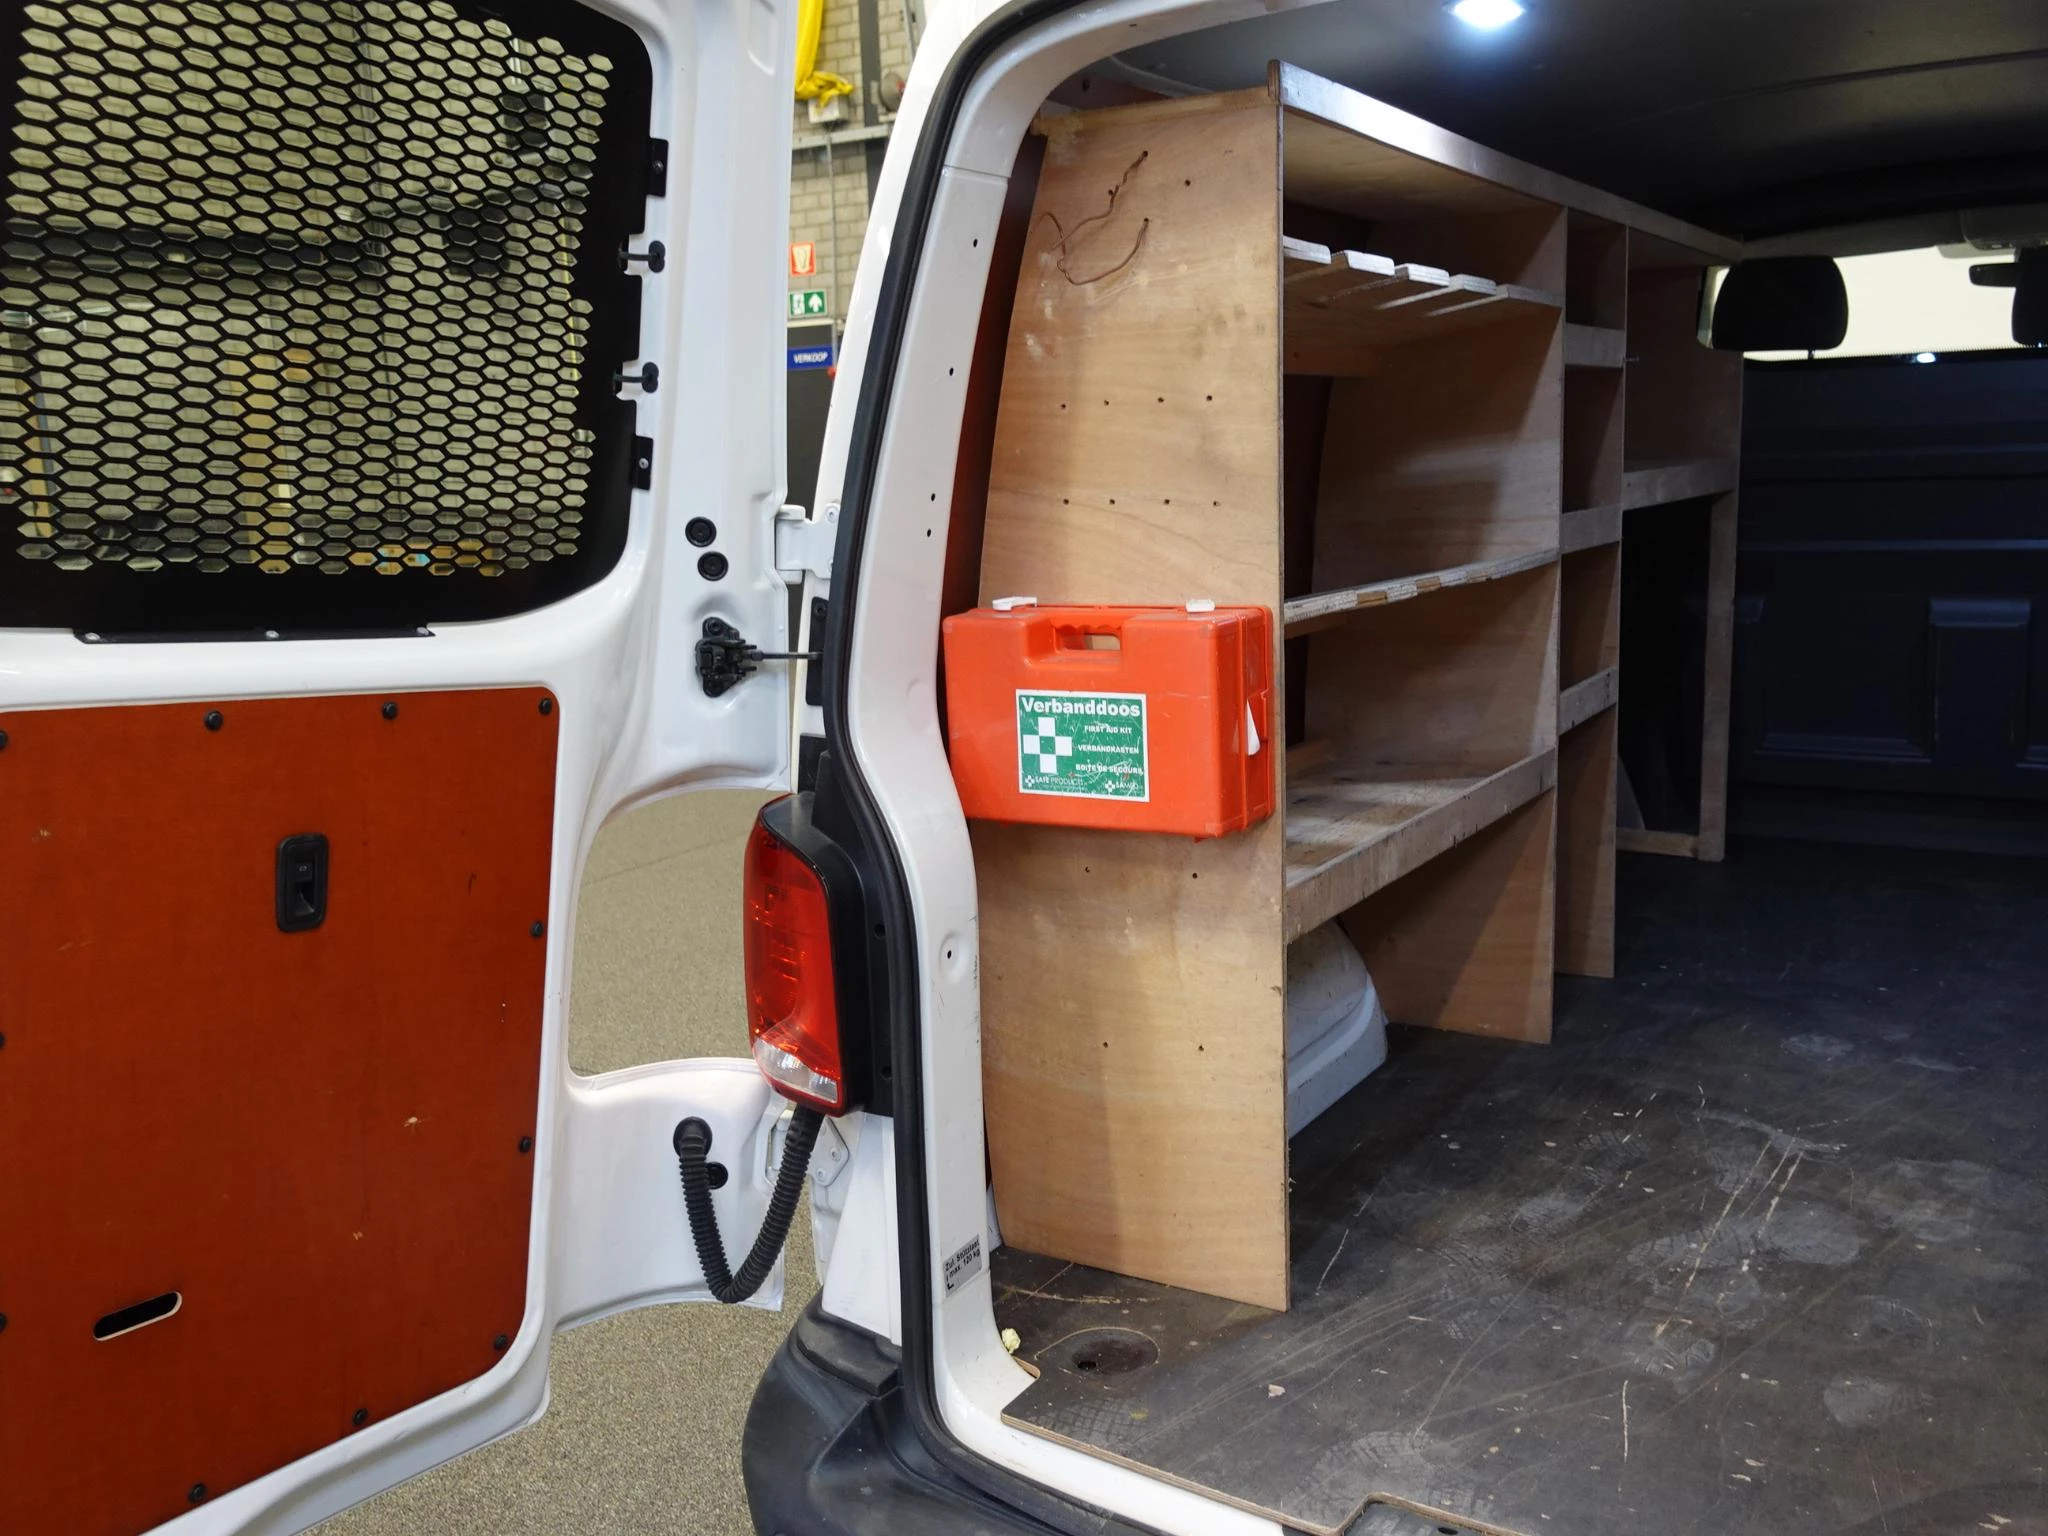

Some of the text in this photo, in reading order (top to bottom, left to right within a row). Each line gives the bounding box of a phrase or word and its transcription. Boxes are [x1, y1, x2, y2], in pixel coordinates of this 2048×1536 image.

[793, 351, 828, 363] VERKOOP
[1021, 697, 1140, 717] Verbanddoos
[1084, 725, 1104, 733] FIRST
[1106, 725, 1119, 733] AID
[1035, 775, 1050, 784] SAFE
